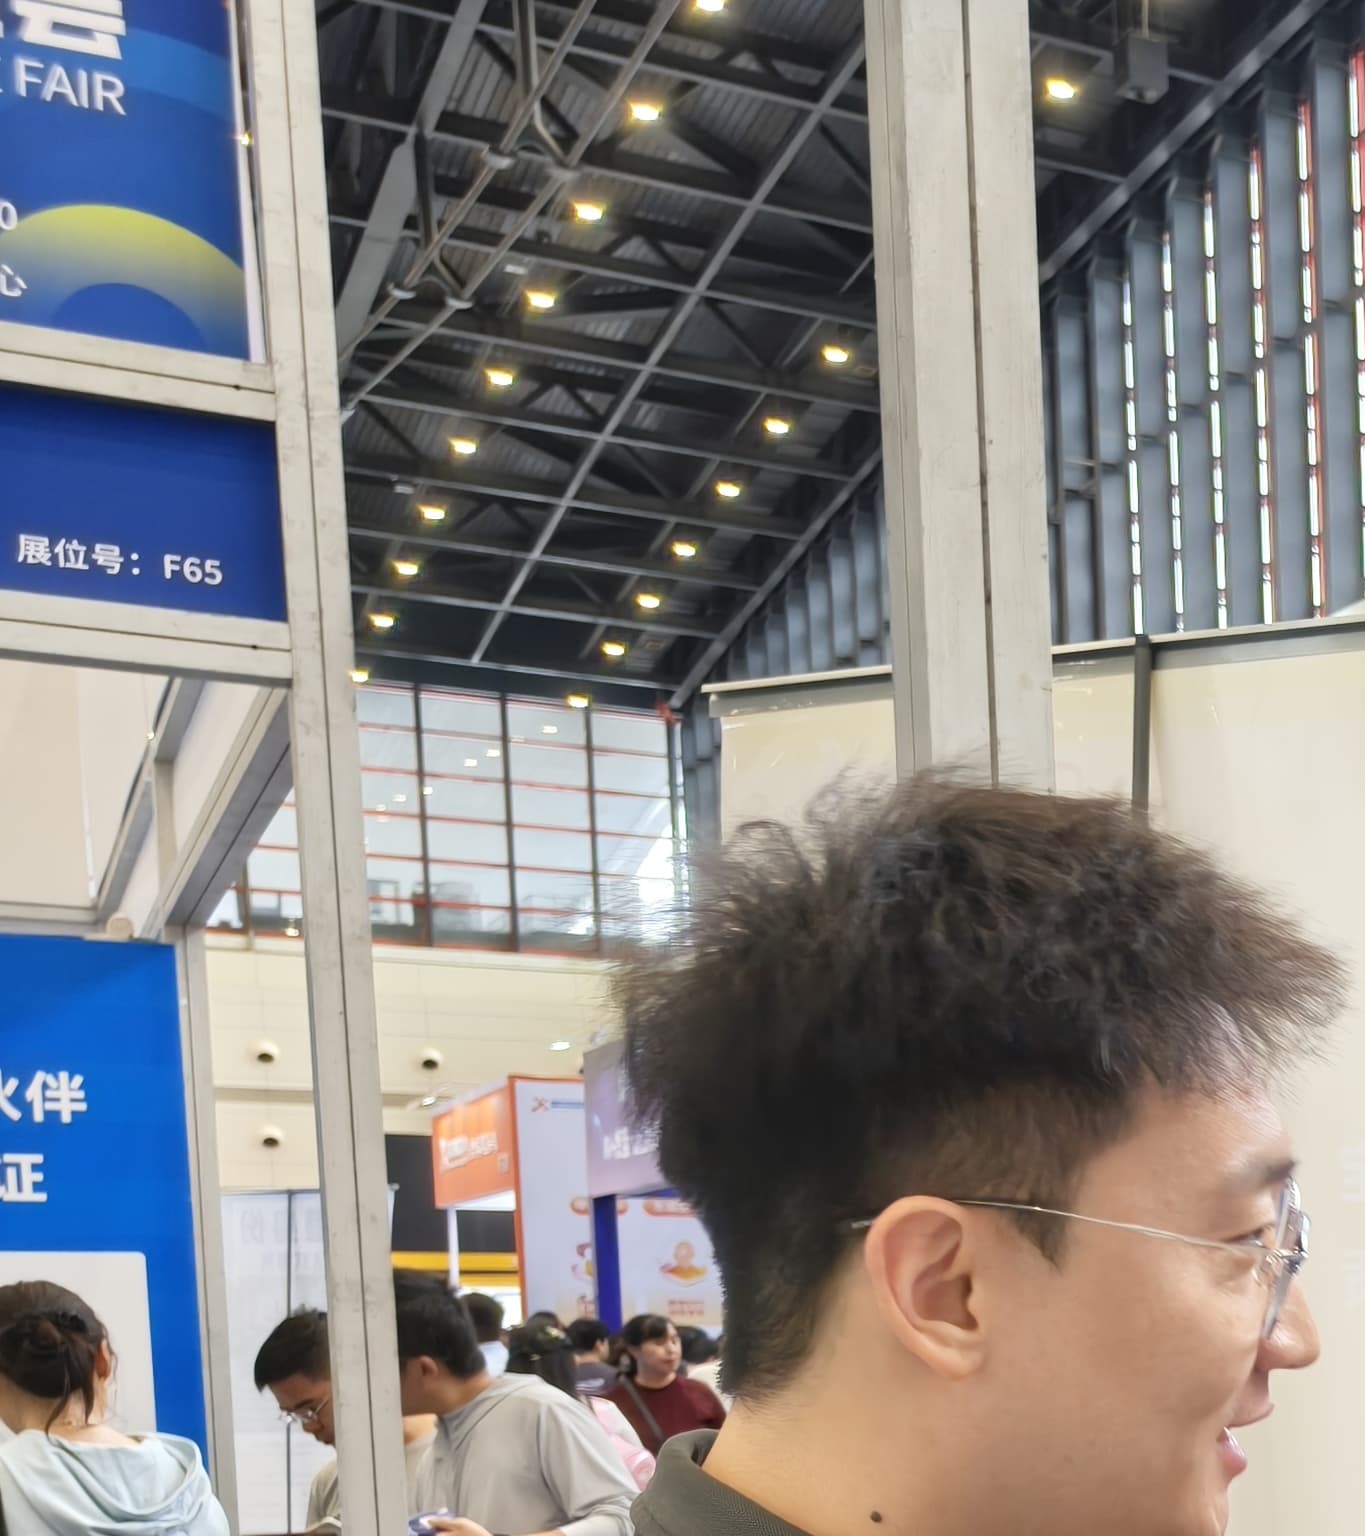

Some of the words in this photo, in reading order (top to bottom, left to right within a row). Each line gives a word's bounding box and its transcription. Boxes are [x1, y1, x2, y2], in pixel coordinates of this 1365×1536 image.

[15, 57, 127, 116] FAIR
[17, 533, 224, 586] 展位号：F65
